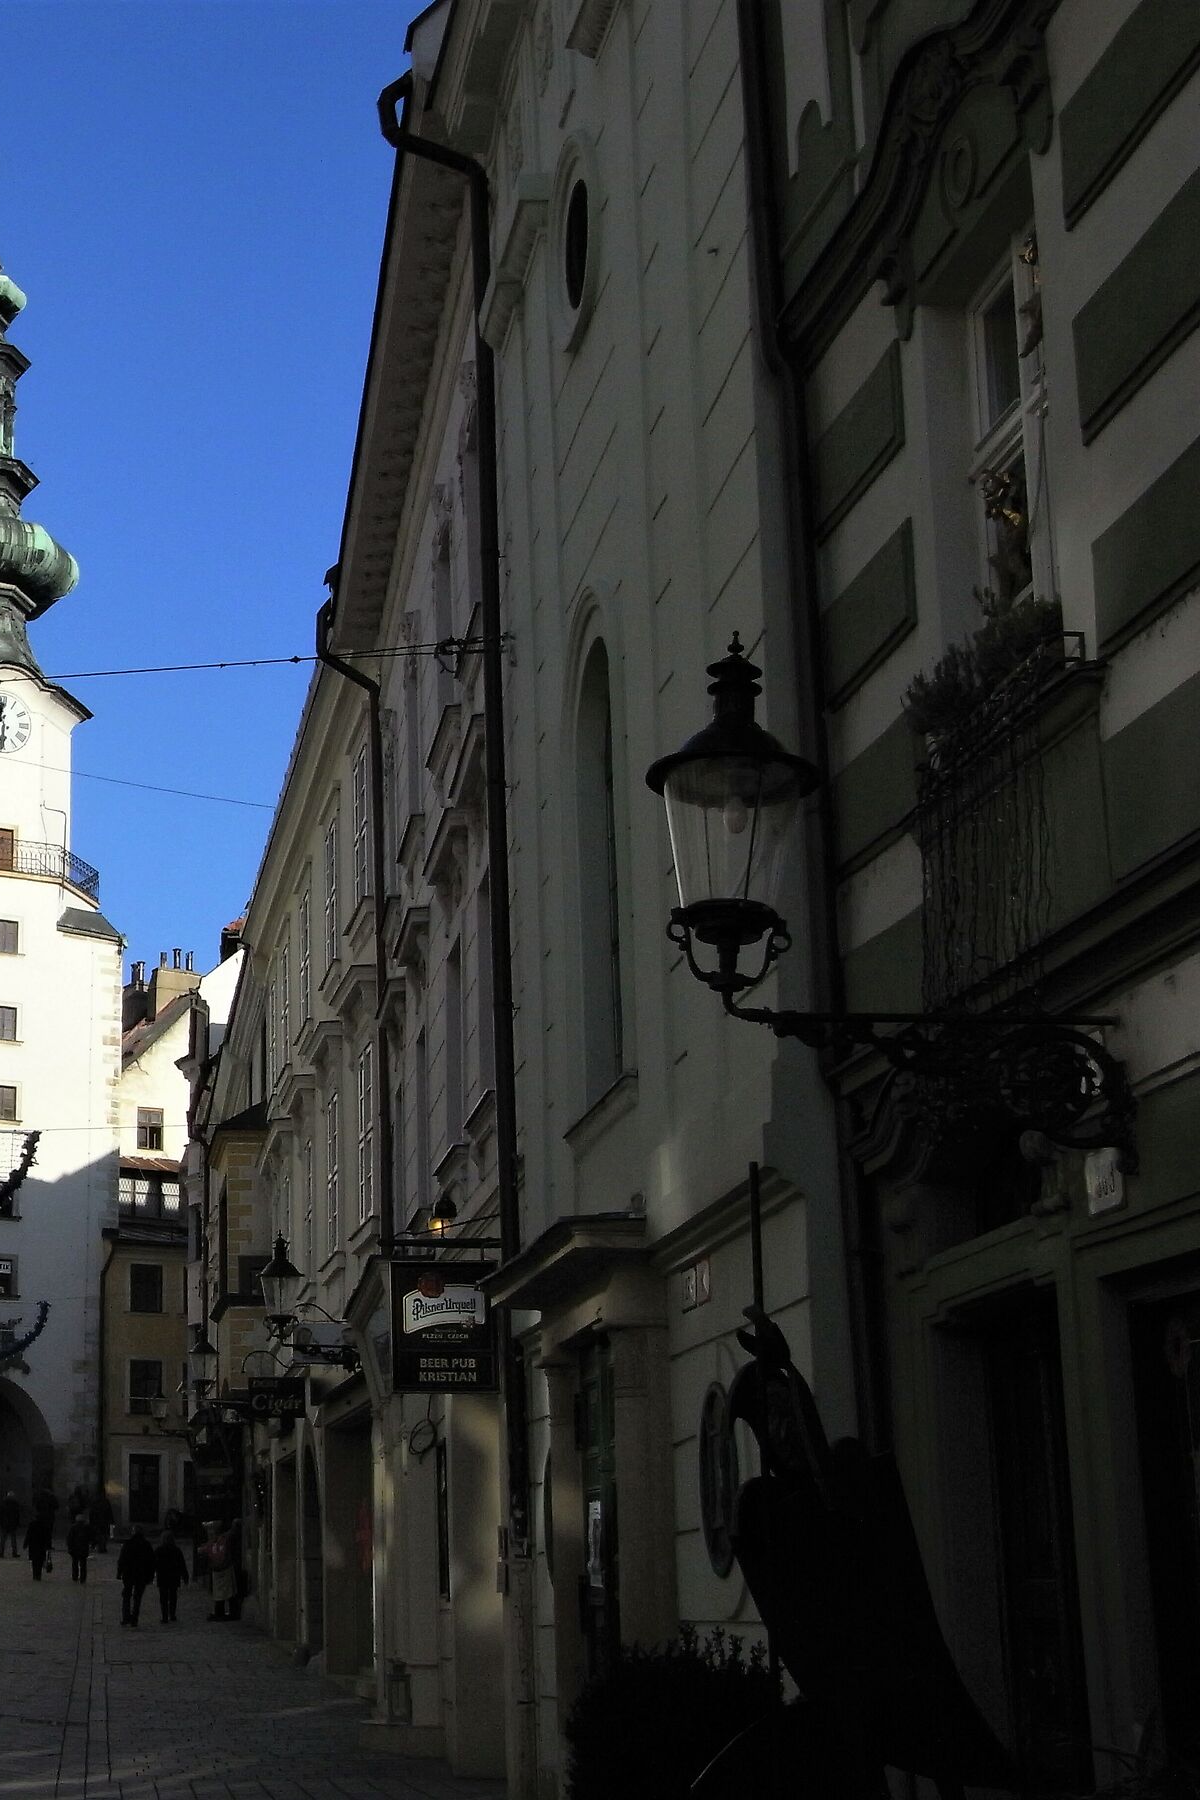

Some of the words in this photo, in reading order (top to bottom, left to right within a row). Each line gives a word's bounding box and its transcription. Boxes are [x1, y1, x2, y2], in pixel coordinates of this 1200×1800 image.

[412, 1298, 445, 1320] Pilsner
[444, 1298, 476, 1314] Urquell
[419, 1357, 451, 1369] BEER
[451, 1357, 476, 1369] PUB
[418, 1371, 477, 1383] KRISTIAN
